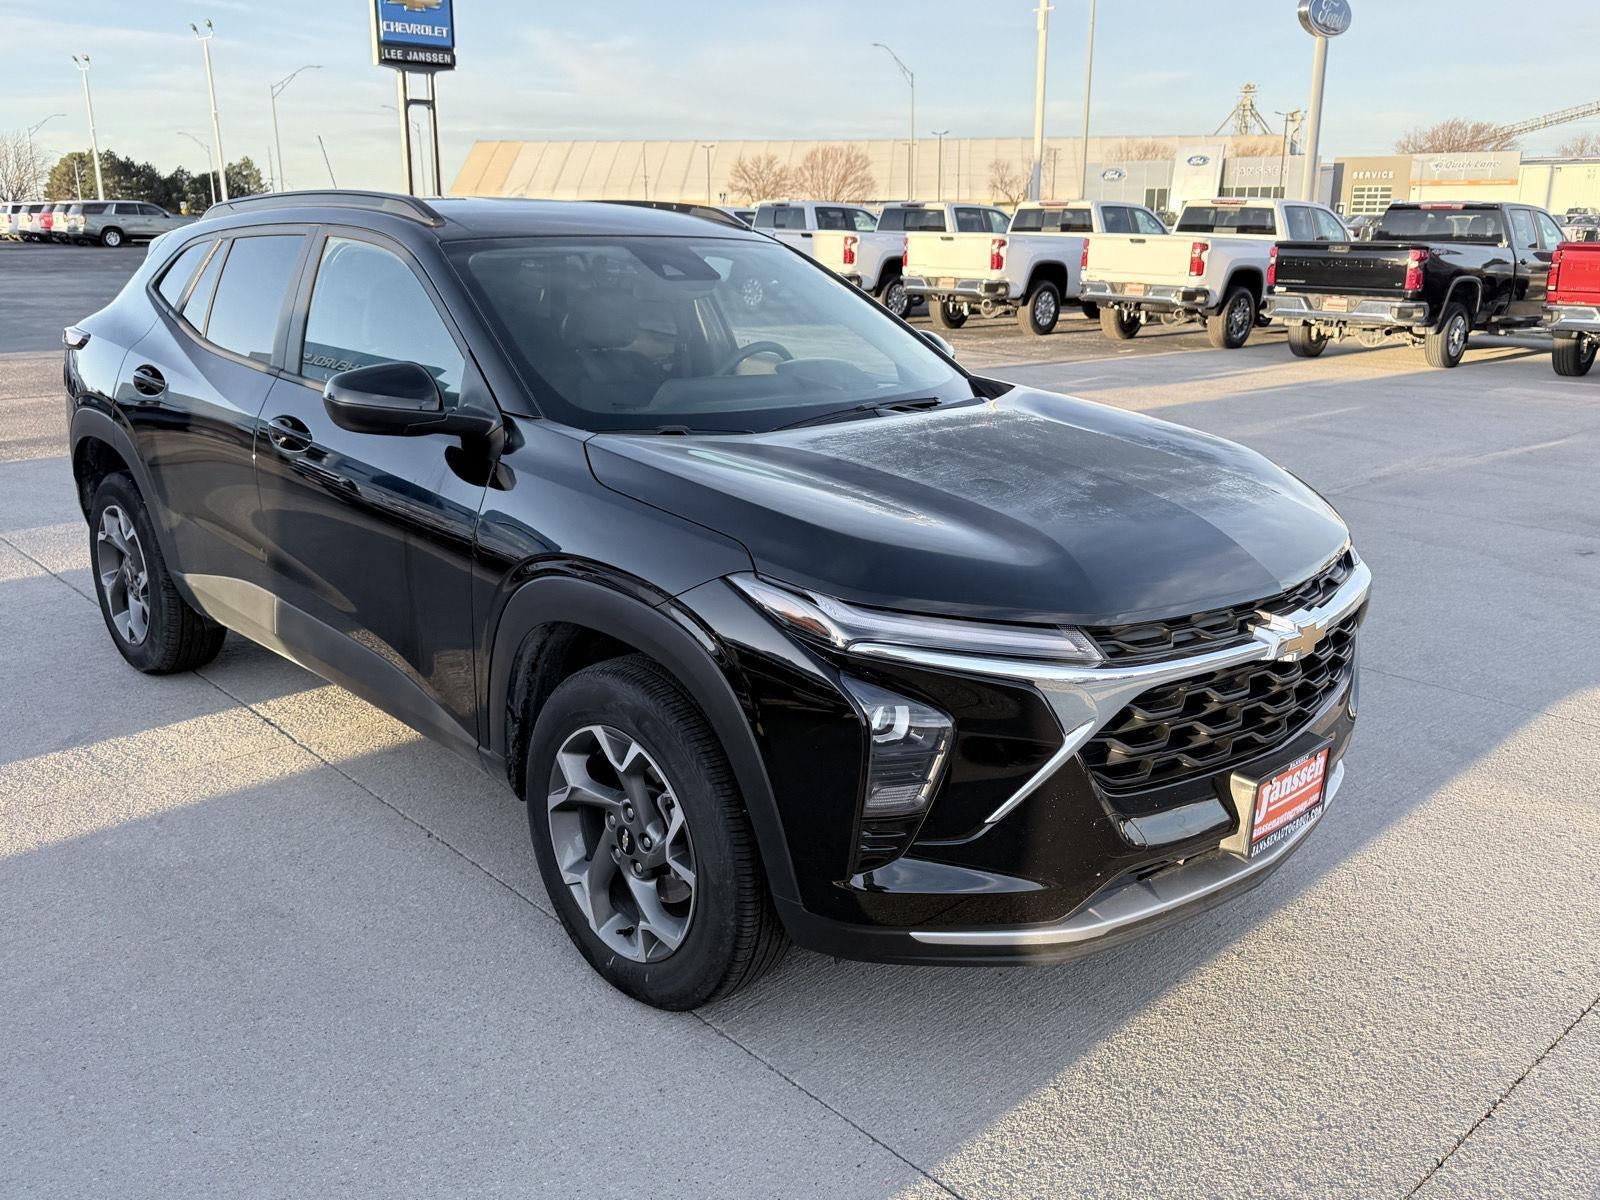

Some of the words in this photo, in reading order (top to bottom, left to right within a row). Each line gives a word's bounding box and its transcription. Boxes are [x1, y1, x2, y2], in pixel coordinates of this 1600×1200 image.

[383, 21, 448, 38] CHEVROLET
[385, 49, 403, 60] LEE
[407, 51, 451, 63] JANSSEN
[1353, 171, 1393, 179] SERVICE
[1254, 755, 1325, 824] Janssen
